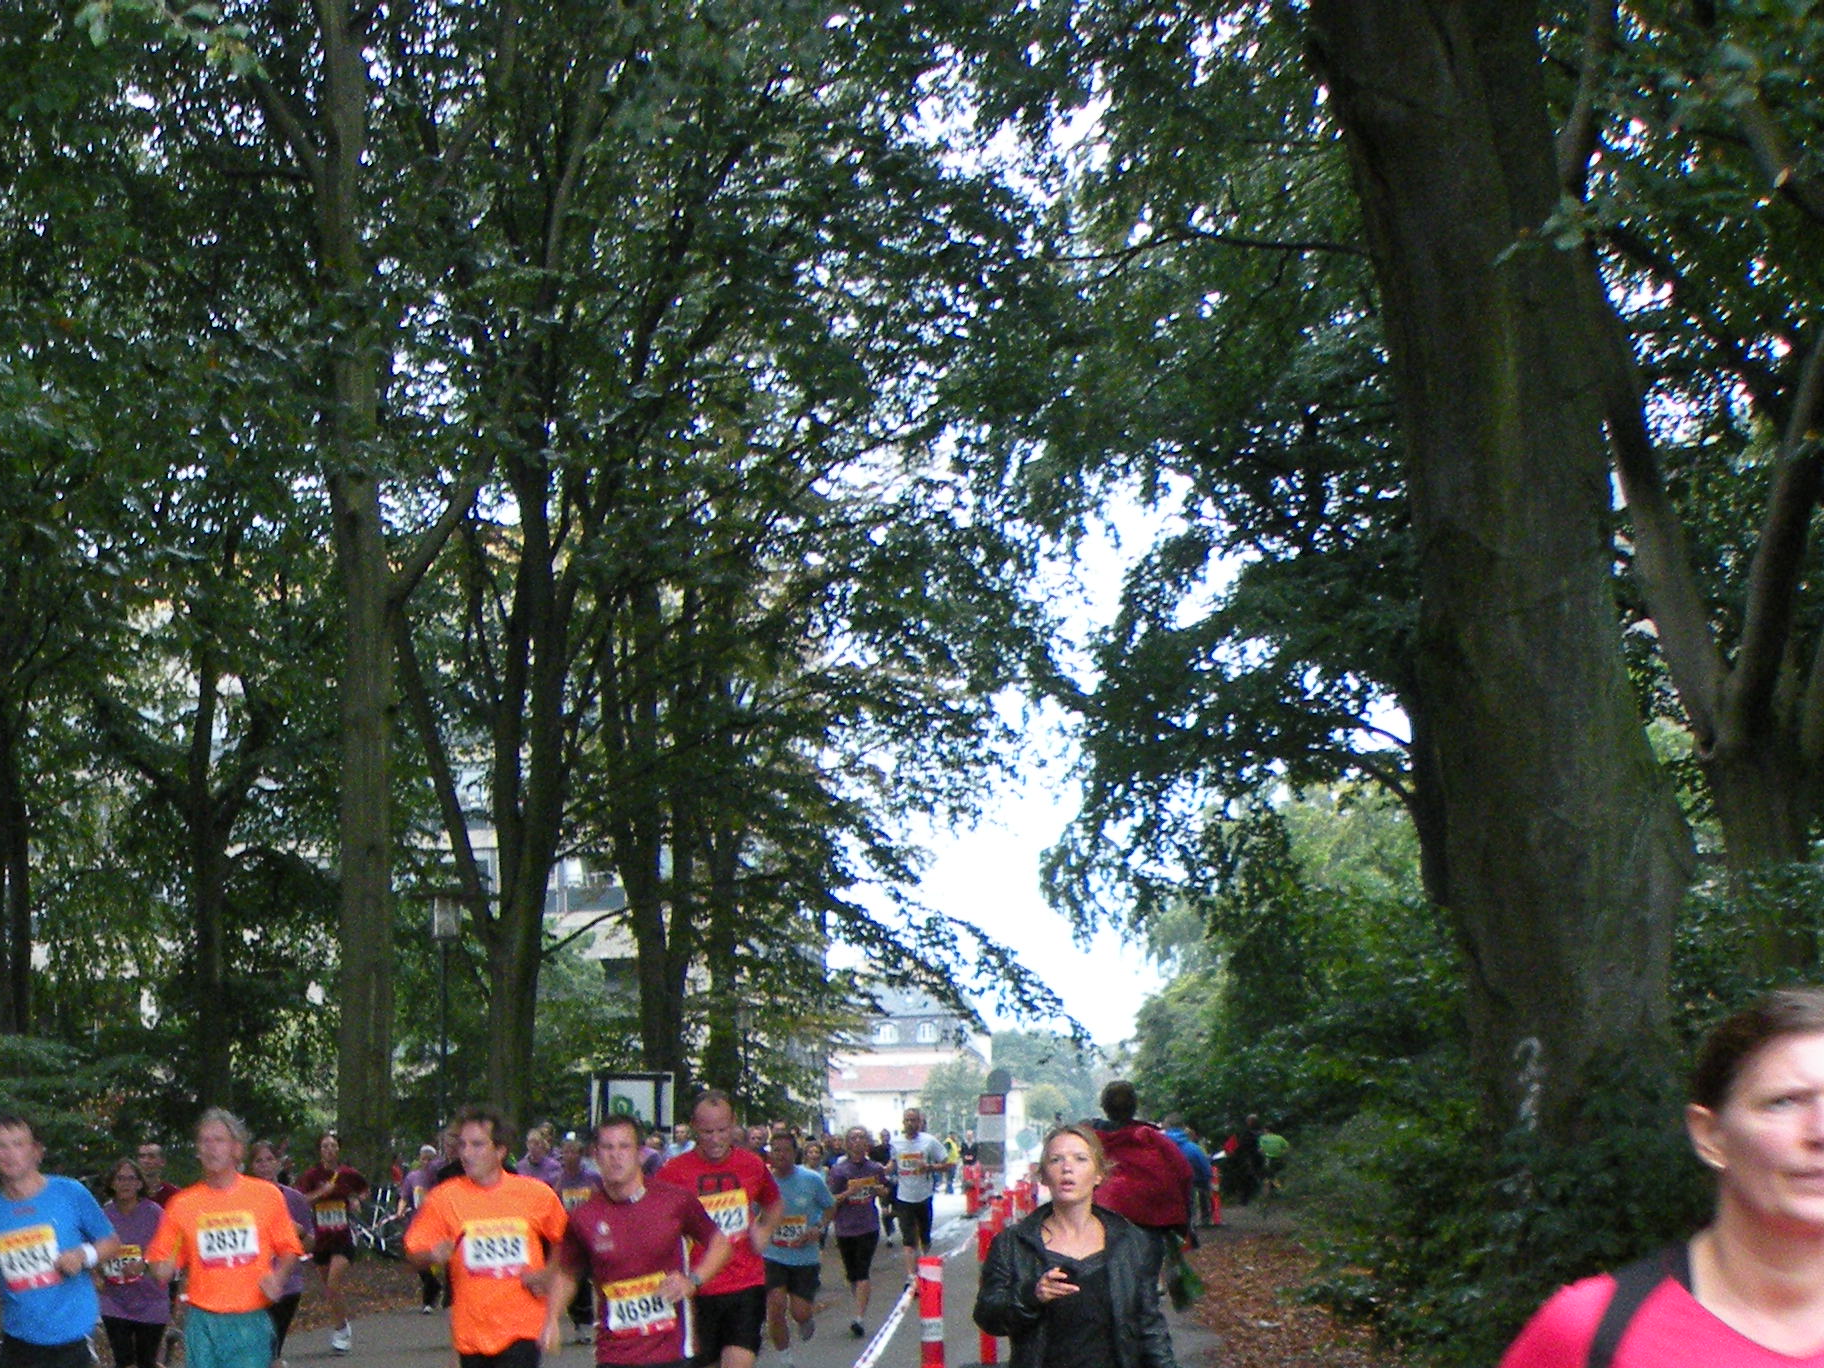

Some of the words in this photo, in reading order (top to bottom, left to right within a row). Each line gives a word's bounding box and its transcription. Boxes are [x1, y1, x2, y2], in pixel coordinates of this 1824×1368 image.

[204, 1228, 249, 1252] 2837
[473, 1236, 521, 1259] 2838
[616, 1294, 664, 1324] 4698
